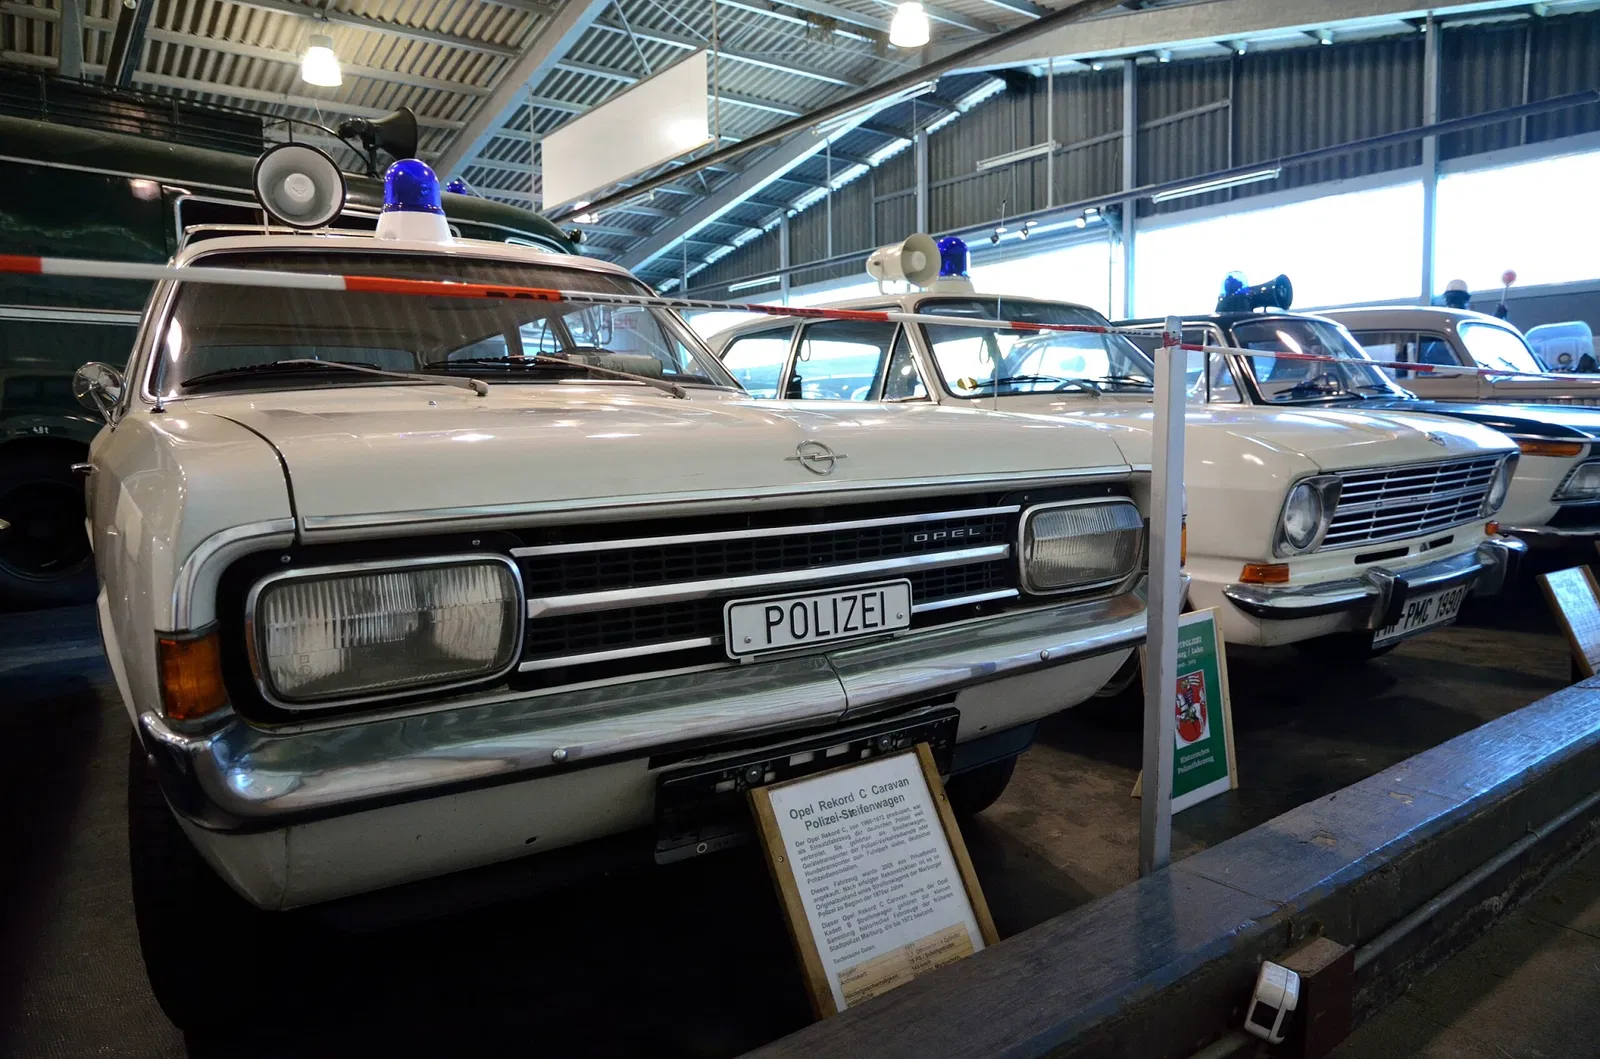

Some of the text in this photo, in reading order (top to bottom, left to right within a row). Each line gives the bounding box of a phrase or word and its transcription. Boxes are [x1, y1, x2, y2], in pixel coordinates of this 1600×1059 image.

[914, 528, 980, 542] OPEL
[1435, 588, 1463, 618] 1990
[766, 591, 886, 644] POLIZEI
[1178, 756, 1214, 774] Polizeifahrzeug
[1180, 748, 1210, 764] Historisches
[789, 778, 910, 820] Opel Rekord C Caravan
[806, 835, 820, 844] Opel
[821, 828, 840, 839] Rekord
[810, 834, 852, 851] Einsatzfahrzeug
[866, 820, 892, 832] deutschen
[894, 814, 911, 824] Polizei
[804, 857, 850, 877] Hundetransporter
[810, 885, 829, 895] Dieses
[833, 875, 858, 887] Fahrzeug
[842, 883, 856, 892] Nach
[818, 906, 836, 918] Polizei
[821, 919, 839, 929] Dieser
[842, 912, 855, 921] Opel
[857, 904, 877, 915] Rekord
[936, 877, 948, 886] Opel
[824, 925, 842, 936] Kadett
[833, 950, 860, 964] Technische
